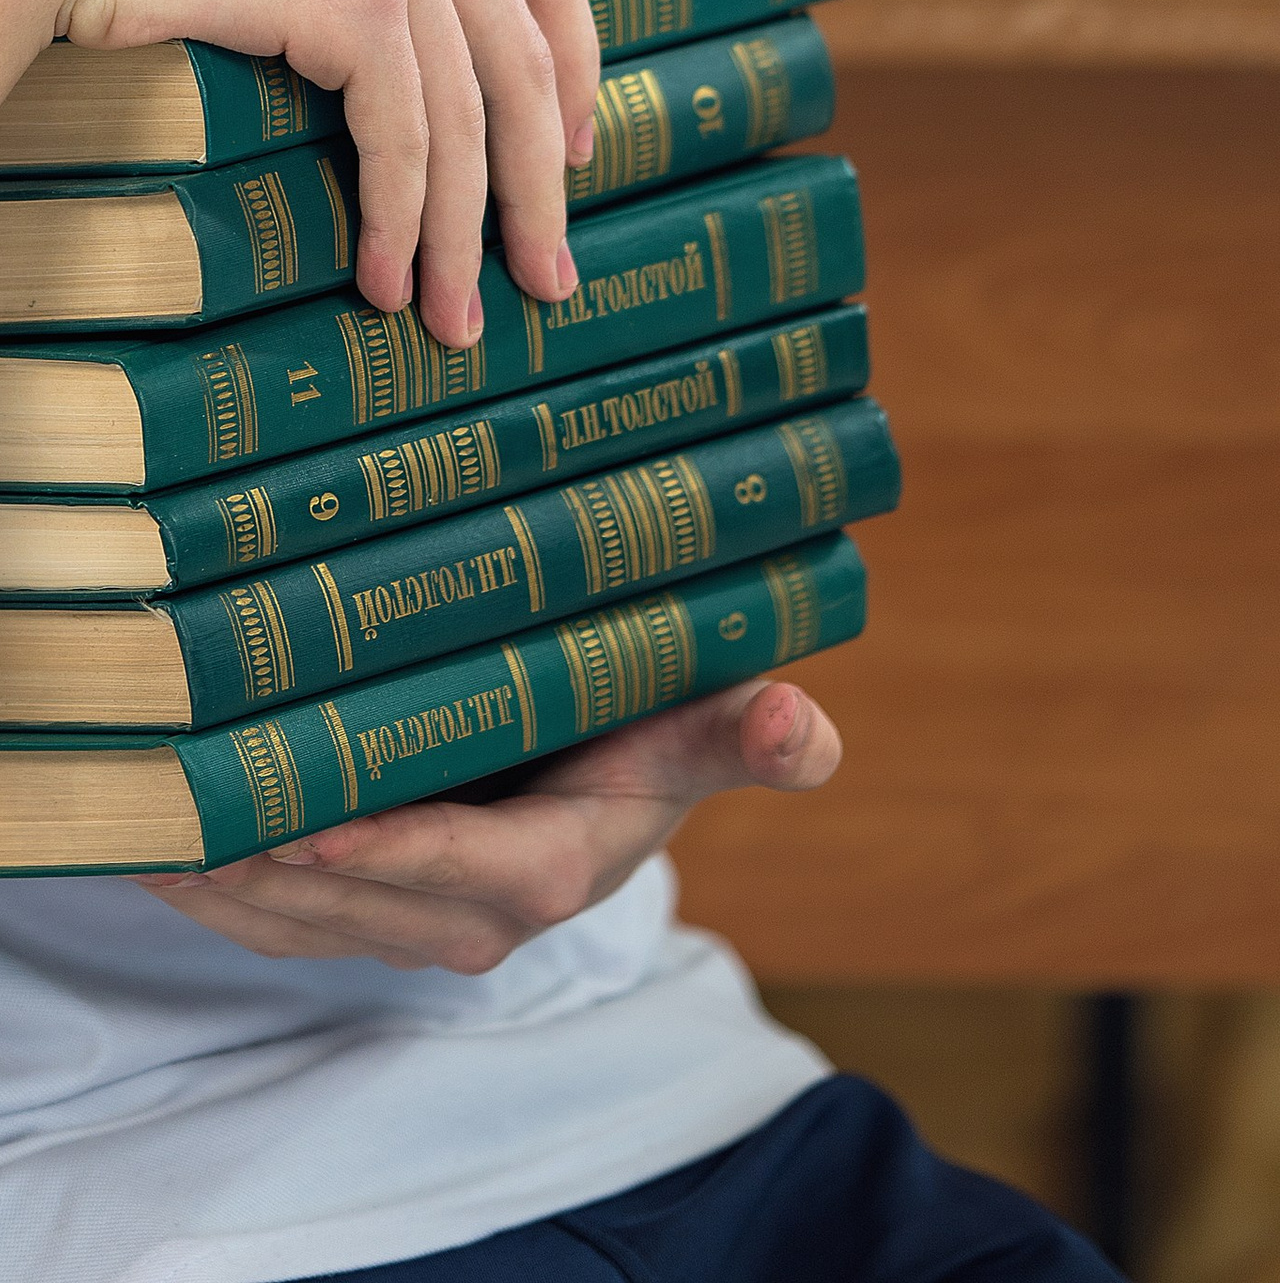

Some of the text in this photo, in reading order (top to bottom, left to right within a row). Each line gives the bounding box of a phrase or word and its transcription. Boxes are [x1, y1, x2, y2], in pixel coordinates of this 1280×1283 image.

[692, 84, 725, 139] 10
[287, 360, 322, 408] 11
[734, 474, 767, 505] 8
[309, 491, 340, 521] 9
[718, 611, 748, 641] 6
